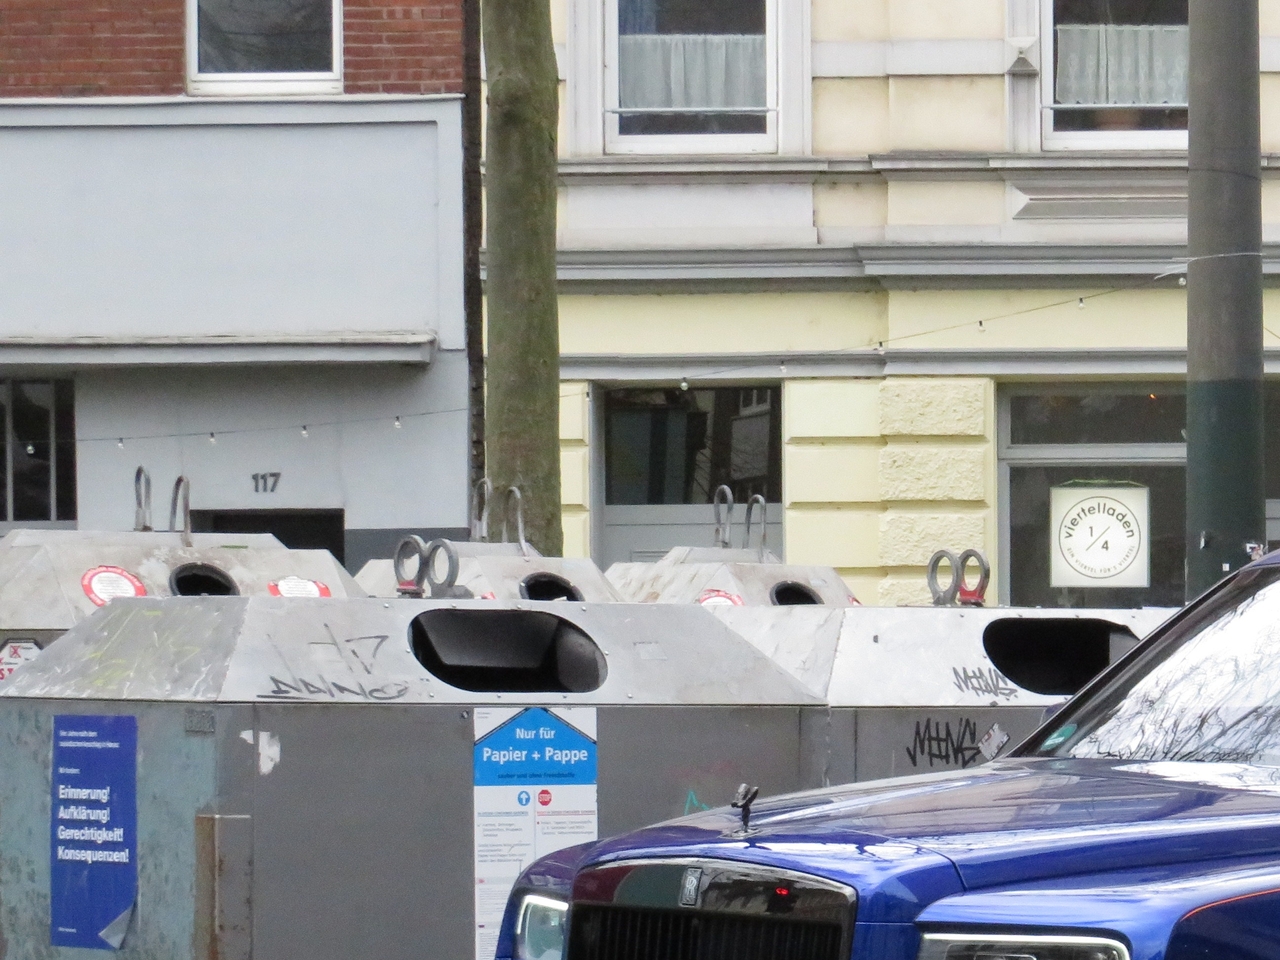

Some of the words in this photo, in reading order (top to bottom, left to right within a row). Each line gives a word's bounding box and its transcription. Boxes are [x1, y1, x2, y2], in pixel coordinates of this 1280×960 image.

[252, 472, 281, 492] 117
[1064, 502, 1135, 539] viertelladen
[516, 728, 536, 739] Nur
[540, 727, 556, 739] für
[483, 746, 527, 765] Papier
[545, 747, 588, 764] Pappe
[59, 785, 110, 803] Erinnerung!
[58, 805, 110, 823] Aufklärung!
[57, 826, 124, 843] Gerechtigkeit!
[57, 846, 129, 864] Konsequenzen!
